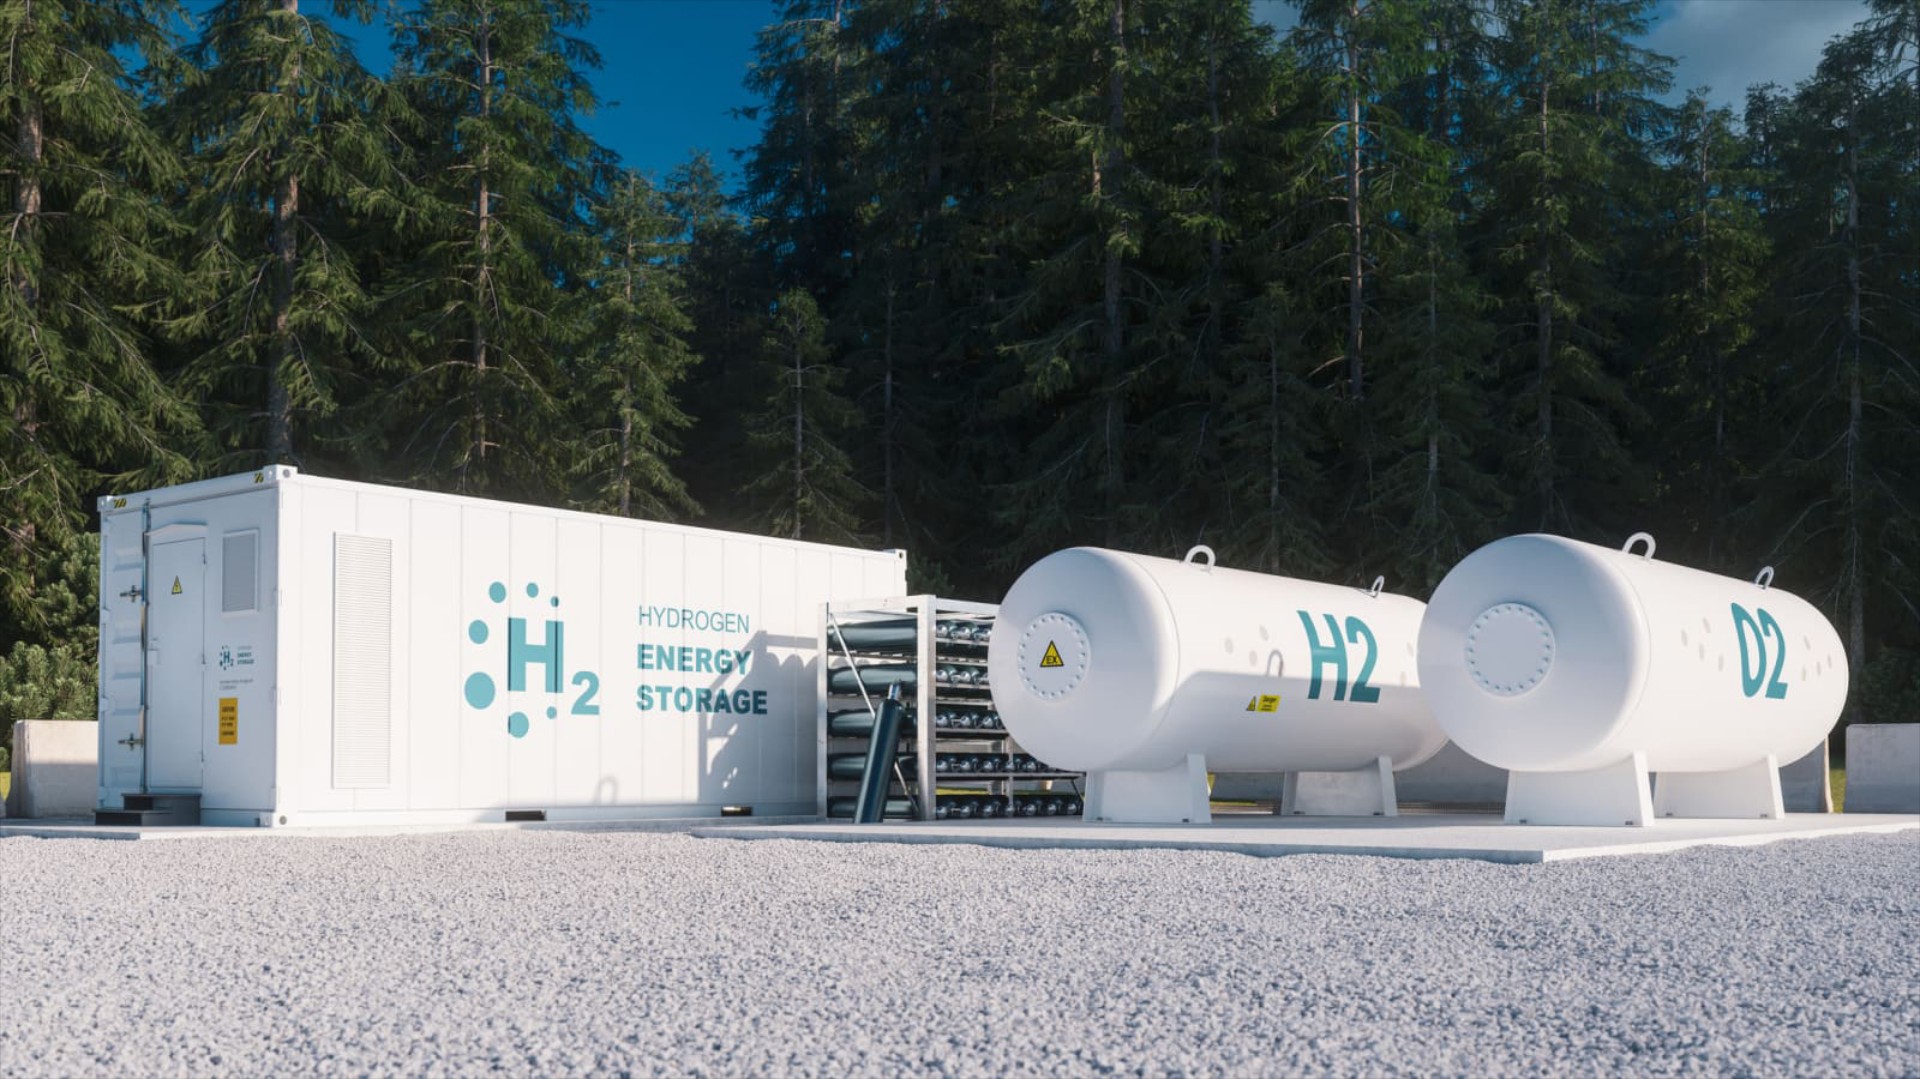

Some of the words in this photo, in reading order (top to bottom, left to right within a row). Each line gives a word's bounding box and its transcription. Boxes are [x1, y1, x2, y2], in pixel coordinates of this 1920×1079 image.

[637, 605, 750, 634] HYDROGEN
[637, 644, 752, 676] ENERGY
[1046, 656, 1058, 664] EX
[1297, 610, 1381, 703] H2
[637, 685, 769, 716] STORAGE
